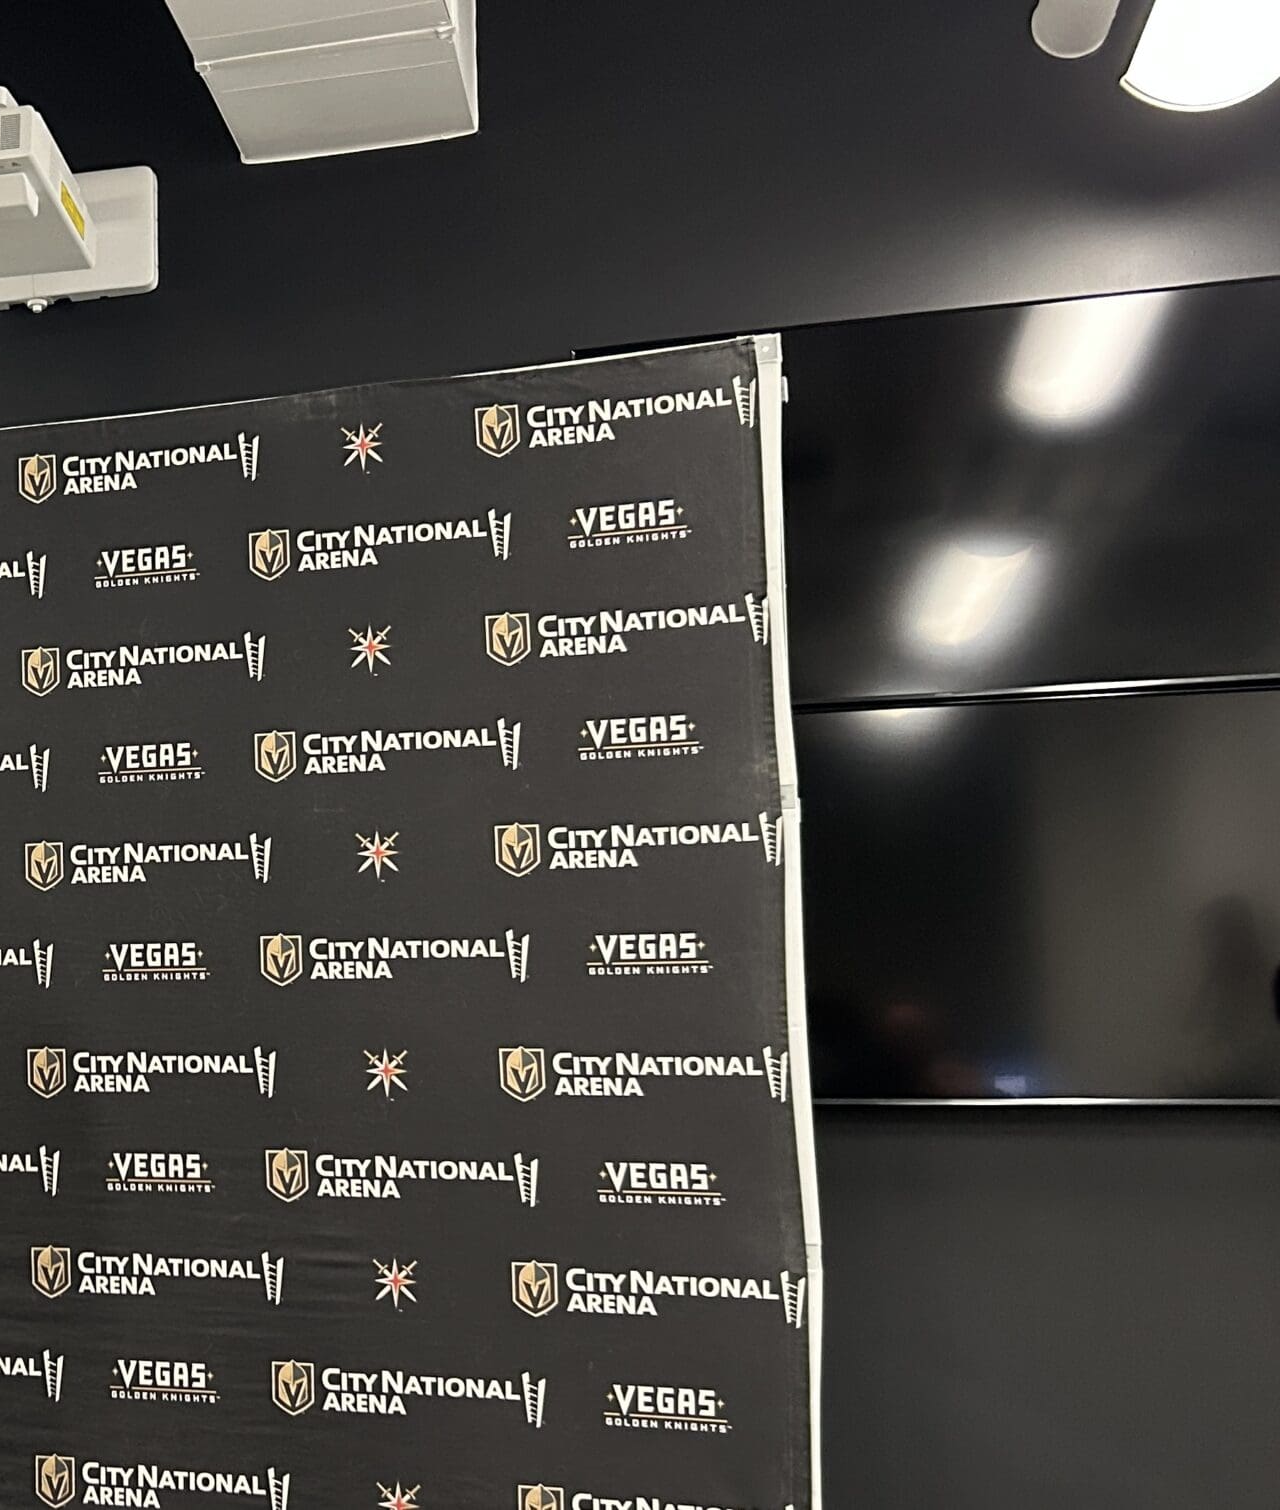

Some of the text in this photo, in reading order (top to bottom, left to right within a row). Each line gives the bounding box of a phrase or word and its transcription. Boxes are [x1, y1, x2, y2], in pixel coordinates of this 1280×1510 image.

[526, 387, 733, 428] CITY NATIONAL
[528, 422, 616, 449] ARENA
[62, 442, 238, 477] CITY NATIONAL
[63, 472, 138, 496] ARENA
[575, 498, 676, 537] VEGAS
[296, 519, 488, 553] CITY NATIONAL
[569, 529, 688, 549] GOLDEN KNIGHTS
[101, 544, 187, 578] VEGAS
[297, 547, 379, 572] ARENA
[95, 572, 196, 589] GOLDEN KNIGHTS
[537, 603, 747, 638] CITY NATIONAL
[66, 641, 244, 671] CITY NATIONAL
[539, 633, 628, 658] ARENA
[66, 667, 143, 689] ARENA
[302, 727, 497, 755] CITY NATIONAL
[585, 714, 688, 750] VEGAS
[105, 742, 191, 774] VEGAS
[303, 753, 387, 775] ARENA
[579, 745, 700, 761] GOLDEN KNIGHTS
[99, 771, 201, 784] GOLDEN KNIGHTS
[547, 822, 760, 850] CITY NATIONAL
[70, 842, 250, 866] CITY NATIONAL
[548, 848, 639, 870] ARENA
[70, 864, 147, 885] ARENA
[109, 942, 197, 972] VEGAS
[309, 936, 506, 960] CITY NATIONAL
[594, 932, 697, 965] VEGAS
[103, 971, 206, 982] GOLDEN KNIGHTS
[310, 960, 394, 980] ARENA
[588, 964, 709, 976] GOLDEN KNIGHTS
[72, 1051, 254, 1074] CITY NATIONAL
[552, 1052, 764, 1077] CITY NATIONAL
[73, 1074, 151, 1093] ARENA
[554, 1076, 645, 1097] ARENA
[112, 1152, 201, 1182] VEGAS
[315, 1154, 515, 1182] CITY NATIONAL
[604, 1161, 709, 1193] VEGAS
[107, 1182, 211, 1193] GOLDEN KNIGHTS
[316, 1178, 401, 1199] ARENA
[598, 1194, 722, 1206] GOLDEN KNIGHTS
[77, 1251, 261, 1280] CITY NATIONAL
[78, 1274, 156, 1296] ARENA
[565, 1267, 780, 1301] CITY NATIONAL
[566, 1292, 658, 1316] ARENA
[117, 1359, 206, 1389] VEGAS
[321, 1367, 521, 1401] CITY NATIONAL
[111, 1390, 216, 1404] GOLDEN KNIGHTS
[322, 1391, 407, 1416] ARENA
[612, 1383, 716, 1417] VEGAS
[605, 1416, 727, 1434] GOLDEN KNIGHTS
[82, 1461, 267, 1496] CITY NATIONAL
[82, 1485, 161, 1509] ARENA
